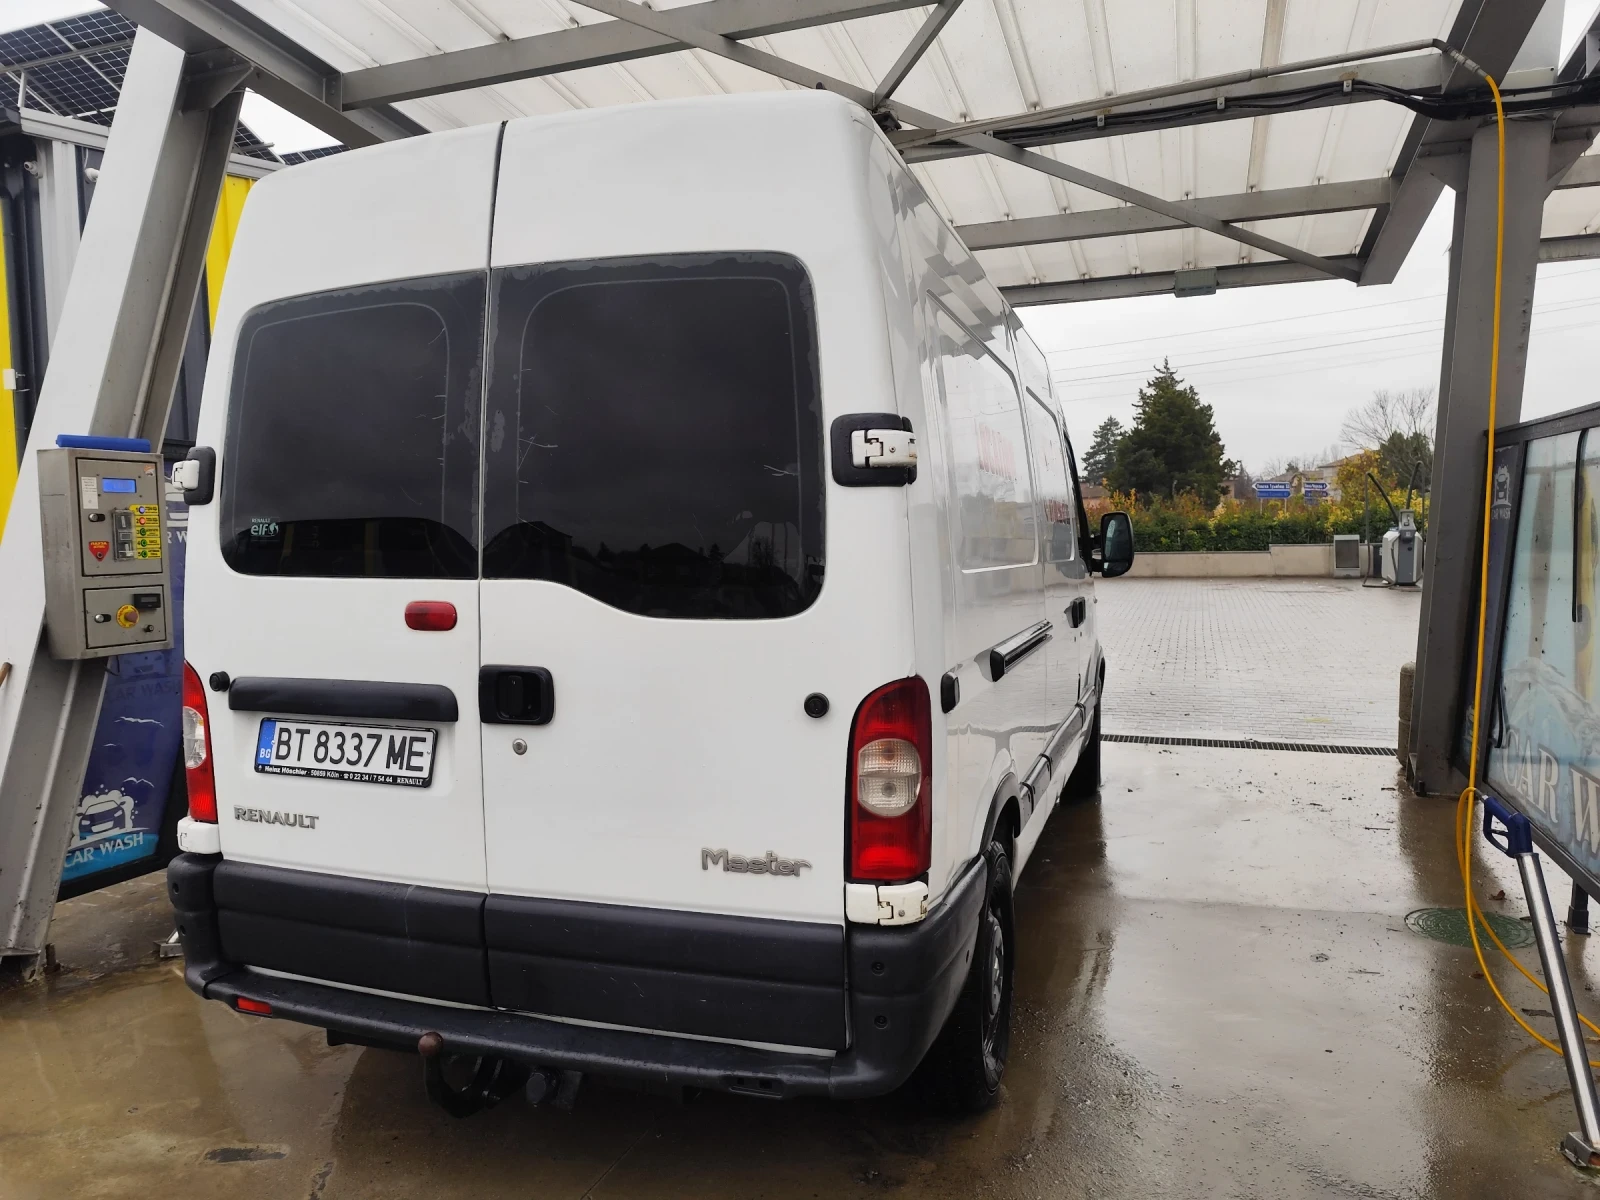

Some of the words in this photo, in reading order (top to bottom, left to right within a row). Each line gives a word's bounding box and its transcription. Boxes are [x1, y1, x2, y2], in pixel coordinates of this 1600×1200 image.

[250, 524, 268, 535] elf
[259, 748, 271, 758] BG
[275, 727, 310, 761] BT
[313, 730, 382, 767] 8337
[386, 735, 427, 772] ME
[264, 765, 281, 773] Heinz
[326, 770, 340, 778] Köln
[396, 777, 423, 785] RENAULT
[1501, 729, 1558, 823] CAR
[233, 805, 319, 829] RENAULT
[99, 832, 144, 856] WASH
[701, 847, 812, 877] Master
